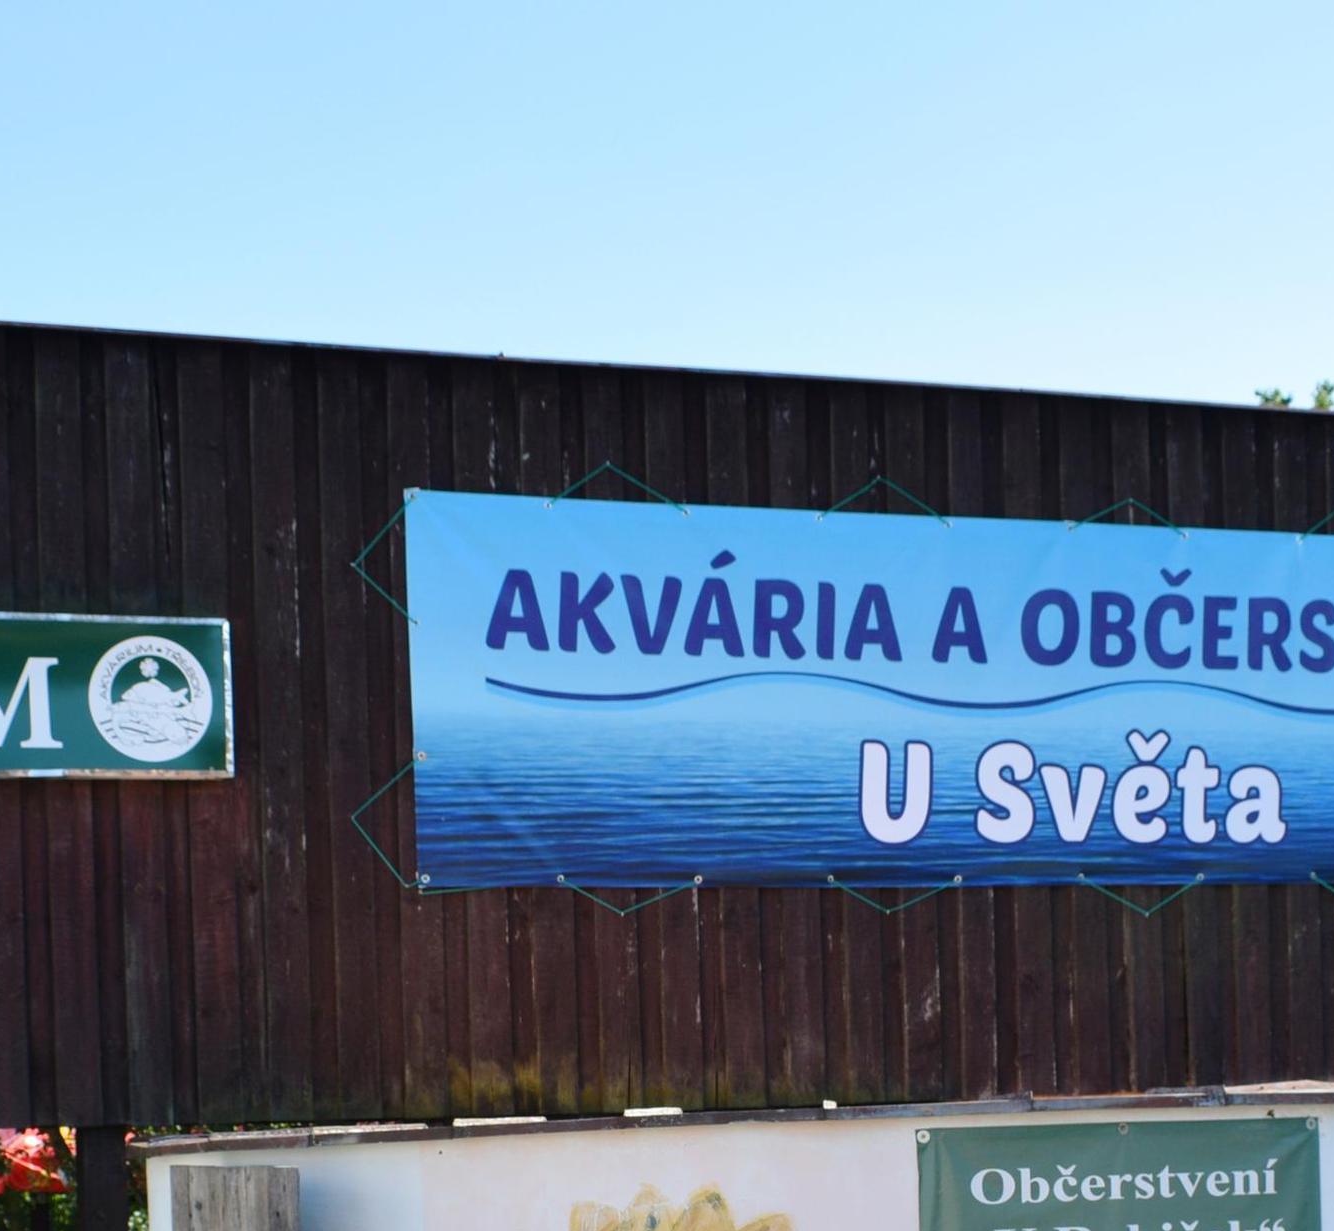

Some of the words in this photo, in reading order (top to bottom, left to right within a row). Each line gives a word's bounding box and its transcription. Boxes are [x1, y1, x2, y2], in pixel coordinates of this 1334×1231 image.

[486, 550, 902, 663] AKVÁRIA
[932, 573, 987, 664] A
[859, 738, 934, 845] U
[976, 729, 1287, 846] Světa
[970, 1158, 1278, 1205] Občerstvení
